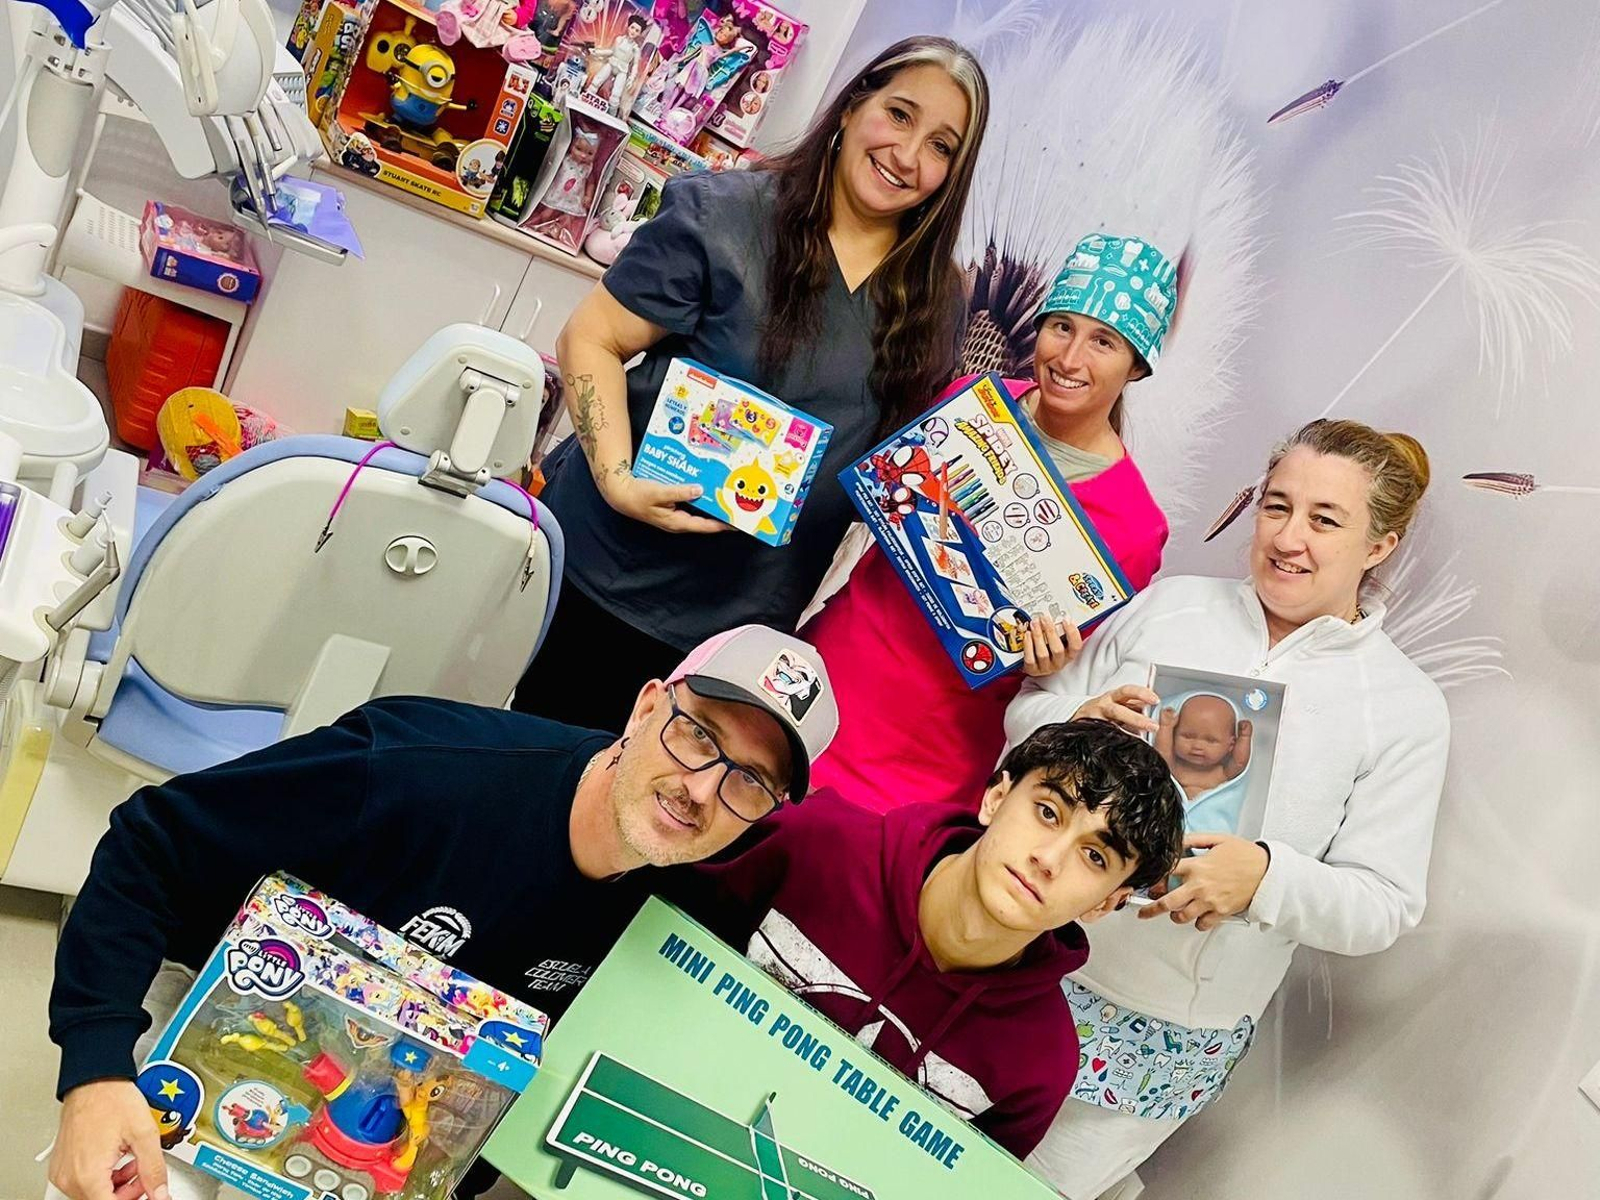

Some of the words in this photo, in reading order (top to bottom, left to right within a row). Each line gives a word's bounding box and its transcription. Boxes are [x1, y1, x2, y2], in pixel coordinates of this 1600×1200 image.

[582, 92, 607, 108] STAR
[383, 170, 410, 185] STUART
[410, 180, 432, 193] SKATE
[431, 189, 442, 197] RC
[643, 443, 668, 461] BABY
[667, 454, 700, 477] SHARK
[954, 420, 989, 454] AMAZING
[982, 448, 1007, 486] FRIENDS
[968, 413, 1018, 476] SPIDEY
[1075, 582, 1100, 609] CREATE
[274, 898, 331, 936] PONY
[399, 915, 466, 958] FEKM
[228, 950, 304, 990] PONY
[258, 950, 287, 967] LITTLE
[528, 979, 567, 992] TEAM
[658, 932, 716, 984] MINI
[712, 972, 771, 1025] PING
[768, 1013, 832, 1072] PONG
[832, 1059, 900, 1122] TABLE
[898, 1111, 965, 1170] GAME
[213, 1154, 249, 1175] Cheese
[249, 1172, 294, 1198] Sandwich
[572, 1131, 638, 1166] PING
[639, 1158, 708, 1198] PONG
[797, 1156, 838, 1183] PONG
[839, 1177, 870, 1199] PING
